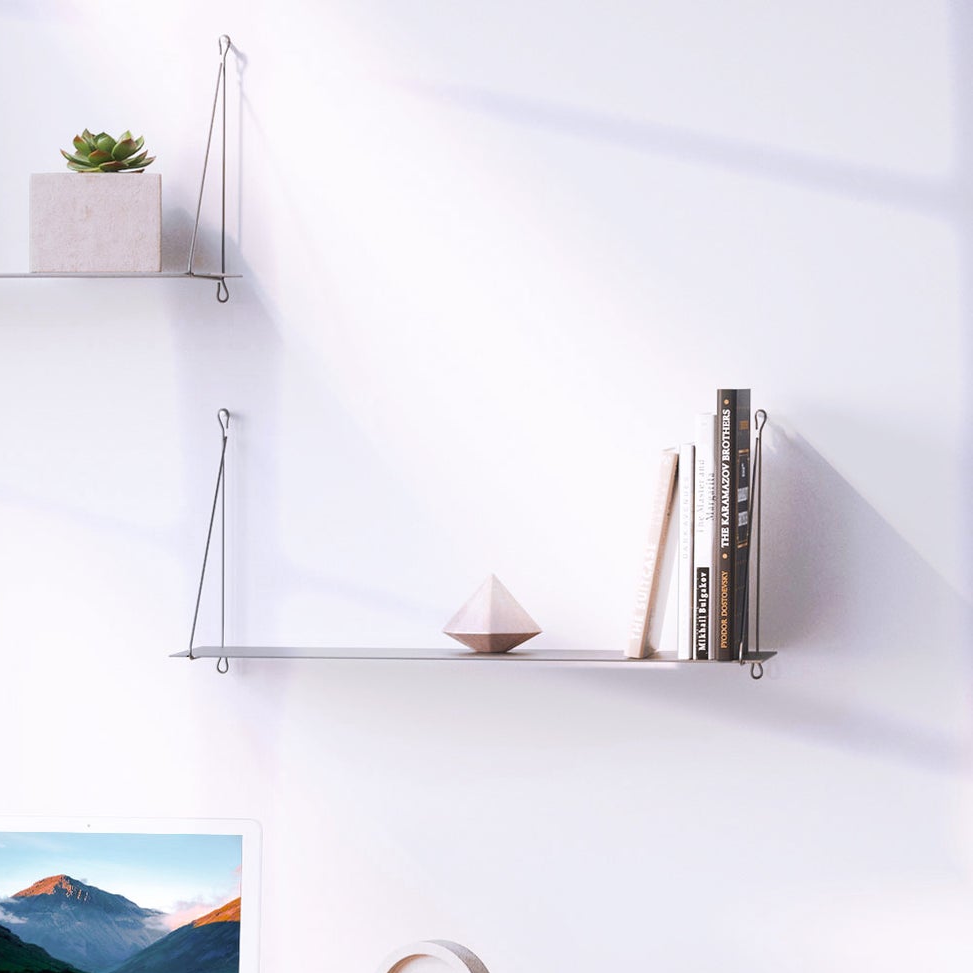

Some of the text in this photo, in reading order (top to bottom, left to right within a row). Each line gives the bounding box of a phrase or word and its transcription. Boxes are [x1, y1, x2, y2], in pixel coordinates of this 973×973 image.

[721, 408, 731, 548] THE KARAMAZOV BROTHERS
[698, 572, 708, 651] Mikhail Bulgakov
[720, 570, 729, 649] FYODOR DOSTOEVSKY
